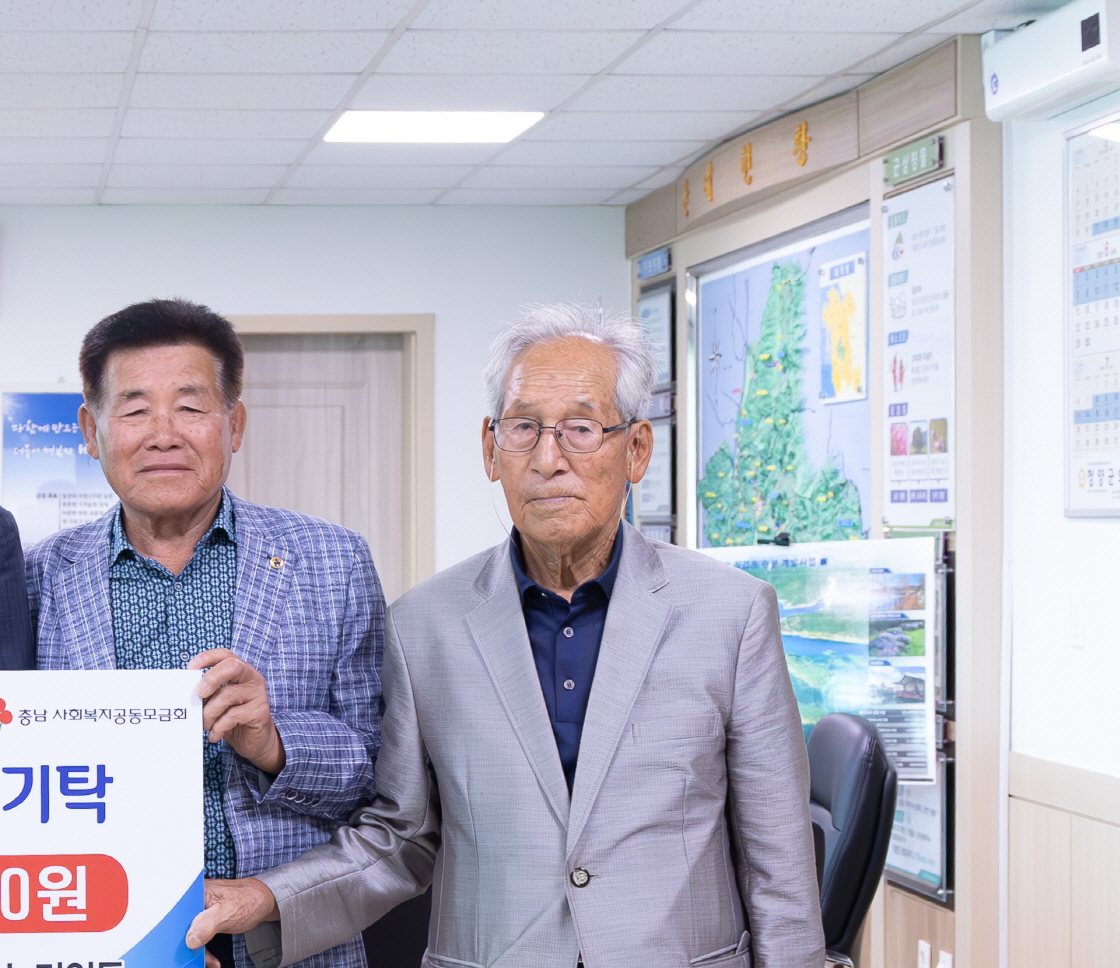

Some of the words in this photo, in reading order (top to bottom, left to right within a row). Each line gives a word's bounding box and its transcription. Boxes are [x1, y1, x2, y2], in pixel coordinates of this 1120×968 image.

[1087, 468, 1120, 487] 청양군
[18, 708, 48, 726] 충남
[52, 707, 187, 725] 사회복지공동모금회
[1, 764, 114, 824] 기탁
